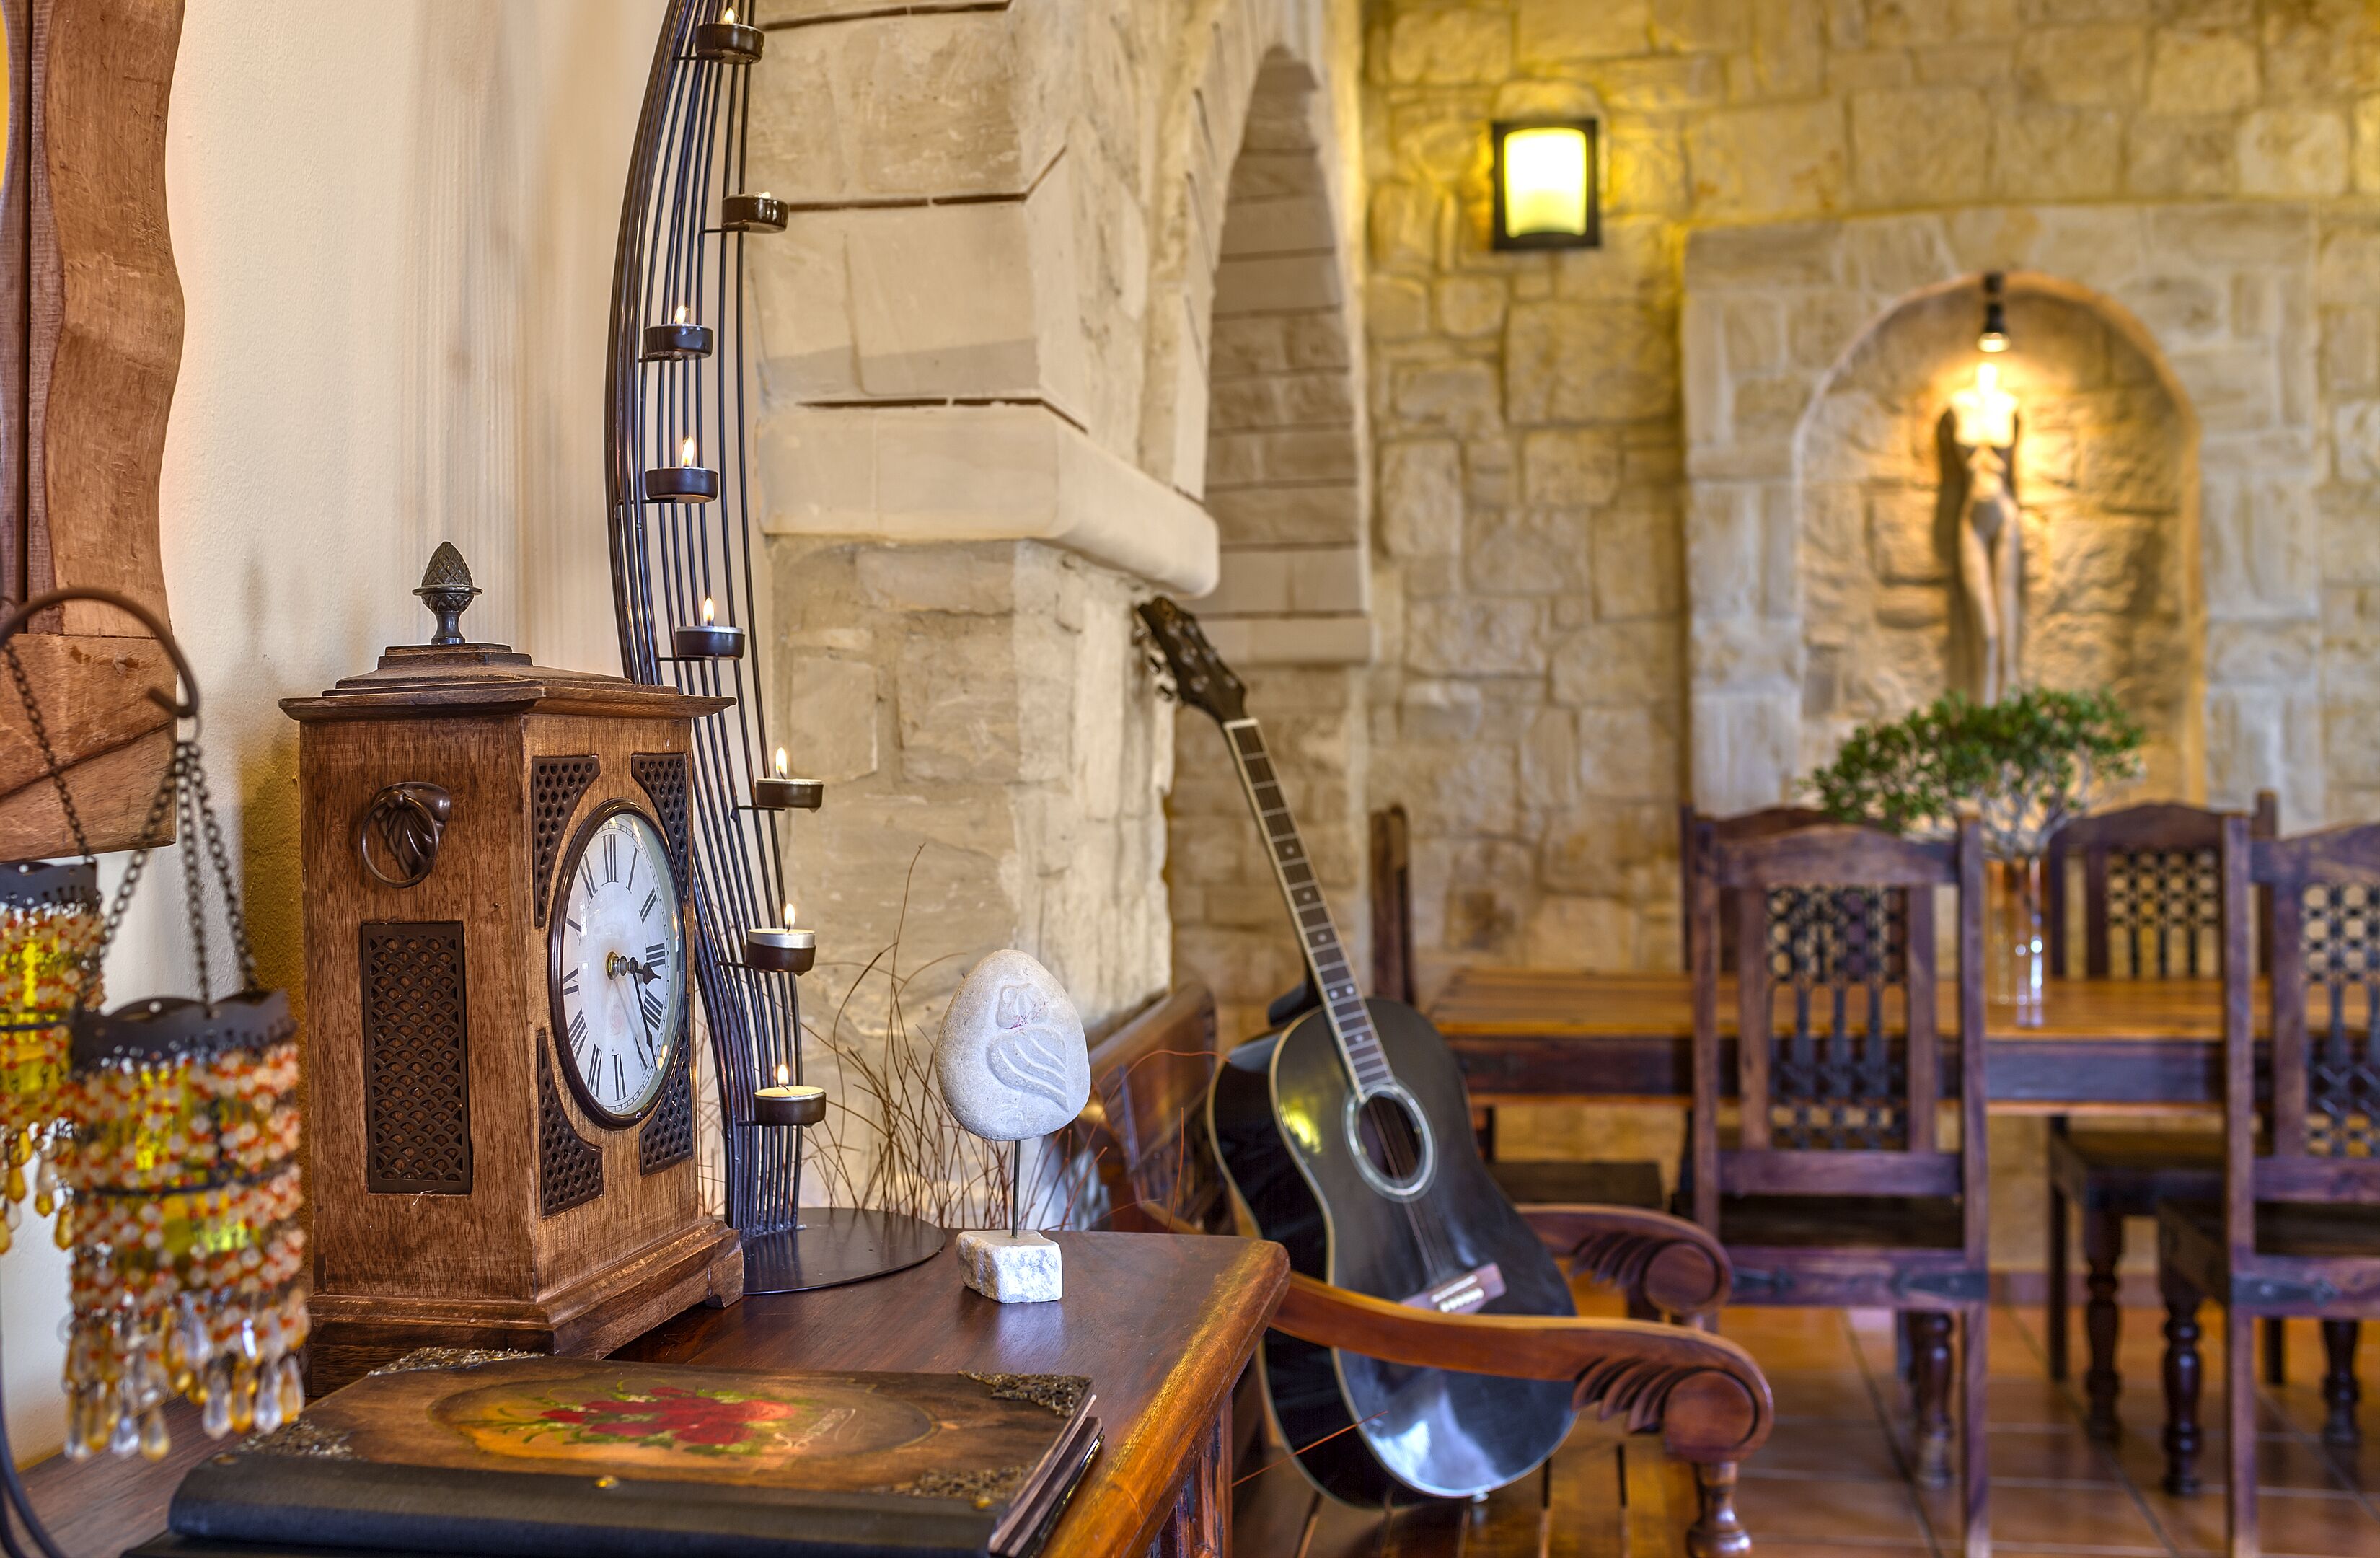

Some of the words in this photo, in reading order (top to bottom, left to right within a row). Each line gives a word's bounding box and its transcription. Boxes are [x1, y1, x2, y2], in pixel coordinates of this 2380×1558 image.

[578, 850, 598, 909] XI
[601, 833, 619, 886] XII
[625, 845, 640, 894] I
[639, 883, 658, 928] II
[645, 938, 666, 969] III
[563, 964, 580, 996] IX
[568, 1004, 589, 1062] VIII
[635, 1036, 649, 1078] V
[586, 1041, 602, 1099] VII
[612, 1053, 628, 1101] VI
